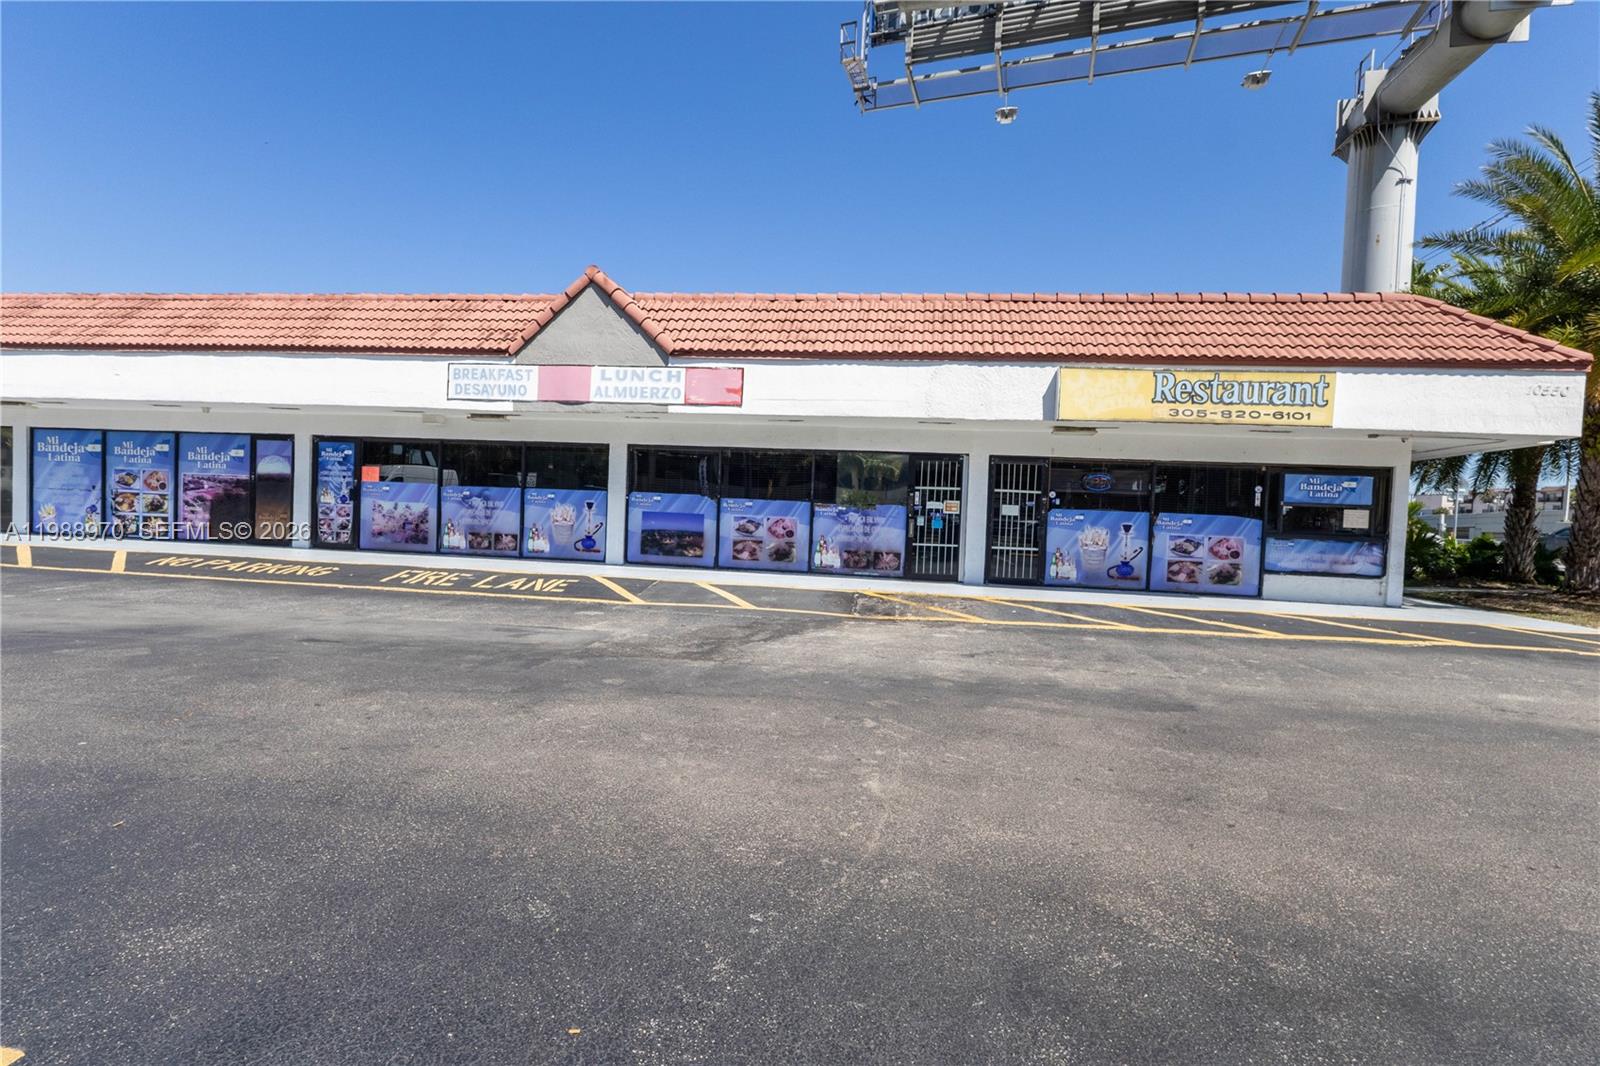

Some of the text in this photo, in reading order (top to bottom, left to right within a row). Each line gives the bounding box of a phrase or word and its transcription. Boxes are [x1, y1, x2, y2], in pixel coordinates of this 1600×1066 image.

[453, 368, 533, 381] BREAKFAST
[600, 369, 682, 383] LUNCH
[454, 383, 528, 397] DESAYUNO
[594, 386, 682, 400] ALMUERZO
[1152, 371, 1330, 408] Restaurant
[1168, 408, 1312, 421] 305-820-6101
[47, 436, 60, 444] Mi
[122, 440, 134, 448] Mi
[37, 442, 85, 454] Bandeja
[114, 446, 156, 458] Bandeja
[196, 446, 208, 454] Mi
[48, 453, 81, 463] Latina
[123, 456, 152, 465] Latina
[187, 451, 231, 463] Bandeja
[197, 461, 227, 470] Latina
[1300, 482, 1343, 493] Bandeja
[1309, 490, 1339, 498] Latina
[145, 556, 579, 592] NO PARKING FIRE LANE
